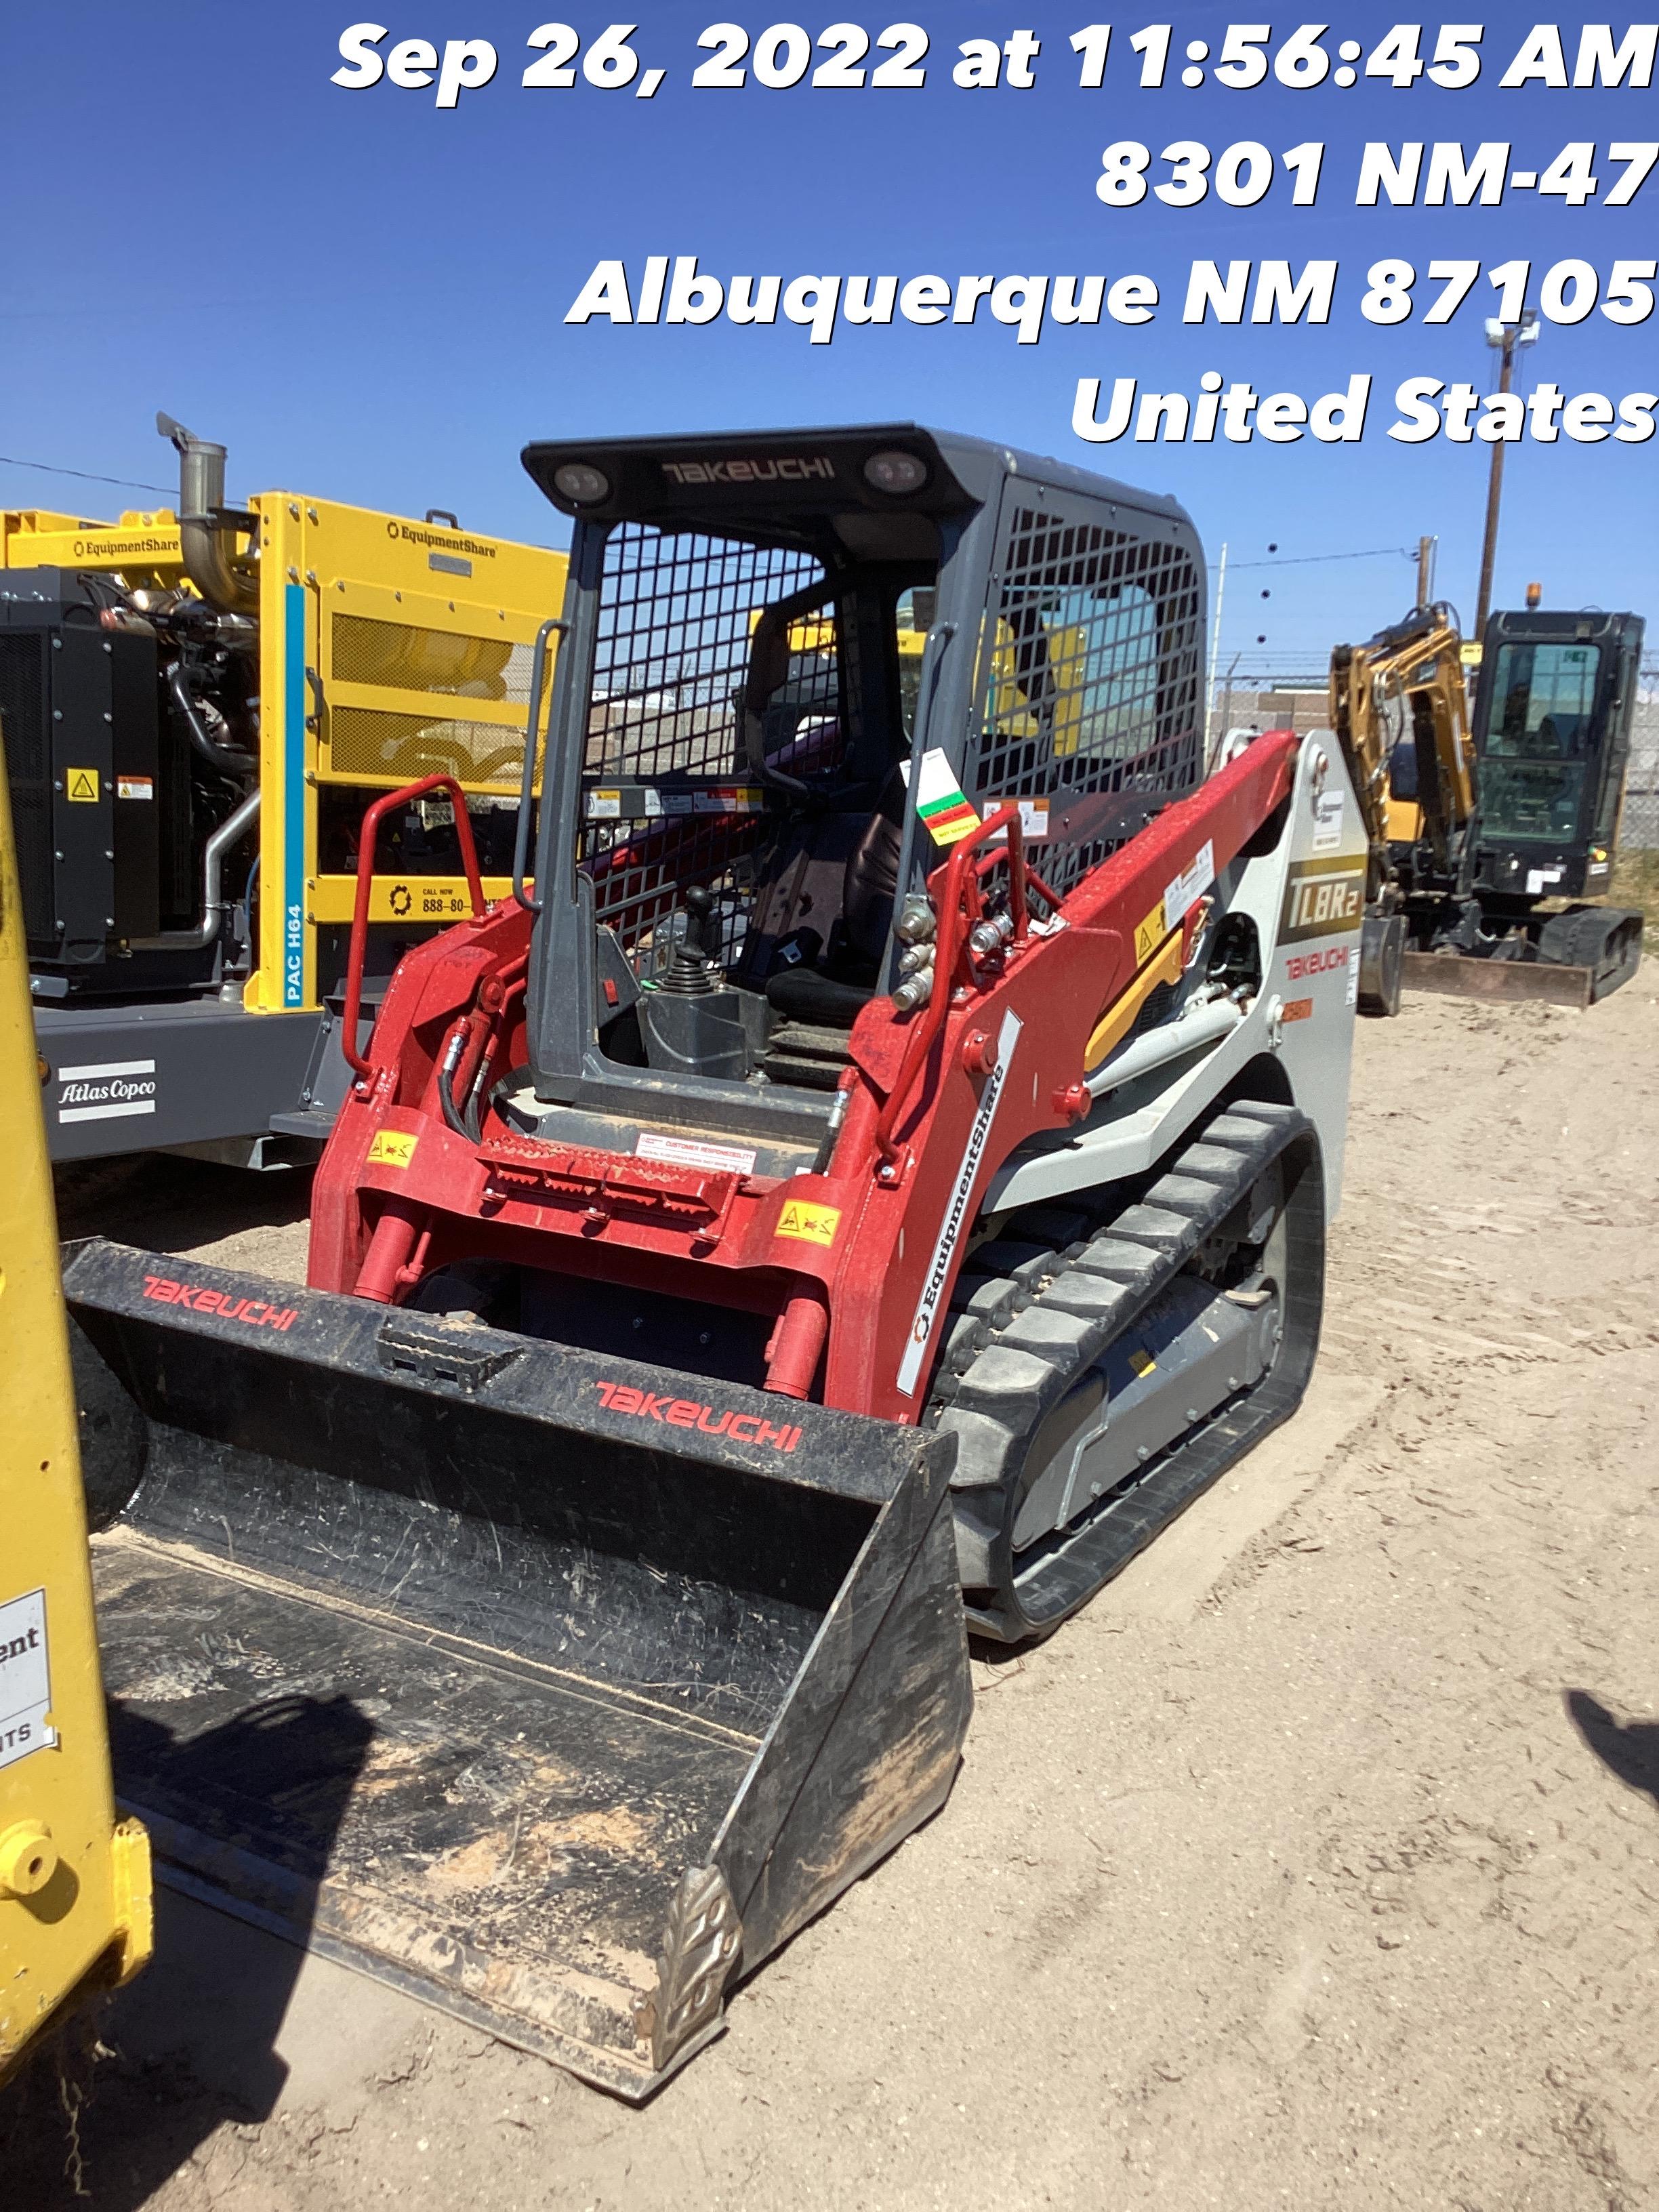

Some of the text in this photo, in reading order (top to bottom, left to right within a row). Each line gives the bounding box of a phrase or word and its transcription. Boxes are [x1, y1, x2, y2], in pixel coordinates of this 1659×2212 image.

[87, 539, 179, 556] EquipmentShare
[401, 525, 495, 558] EquipmentShare
[287, 903, 301, 1000] PAC H64
[923, 1064, 1004, 1310] EquipmentShare
